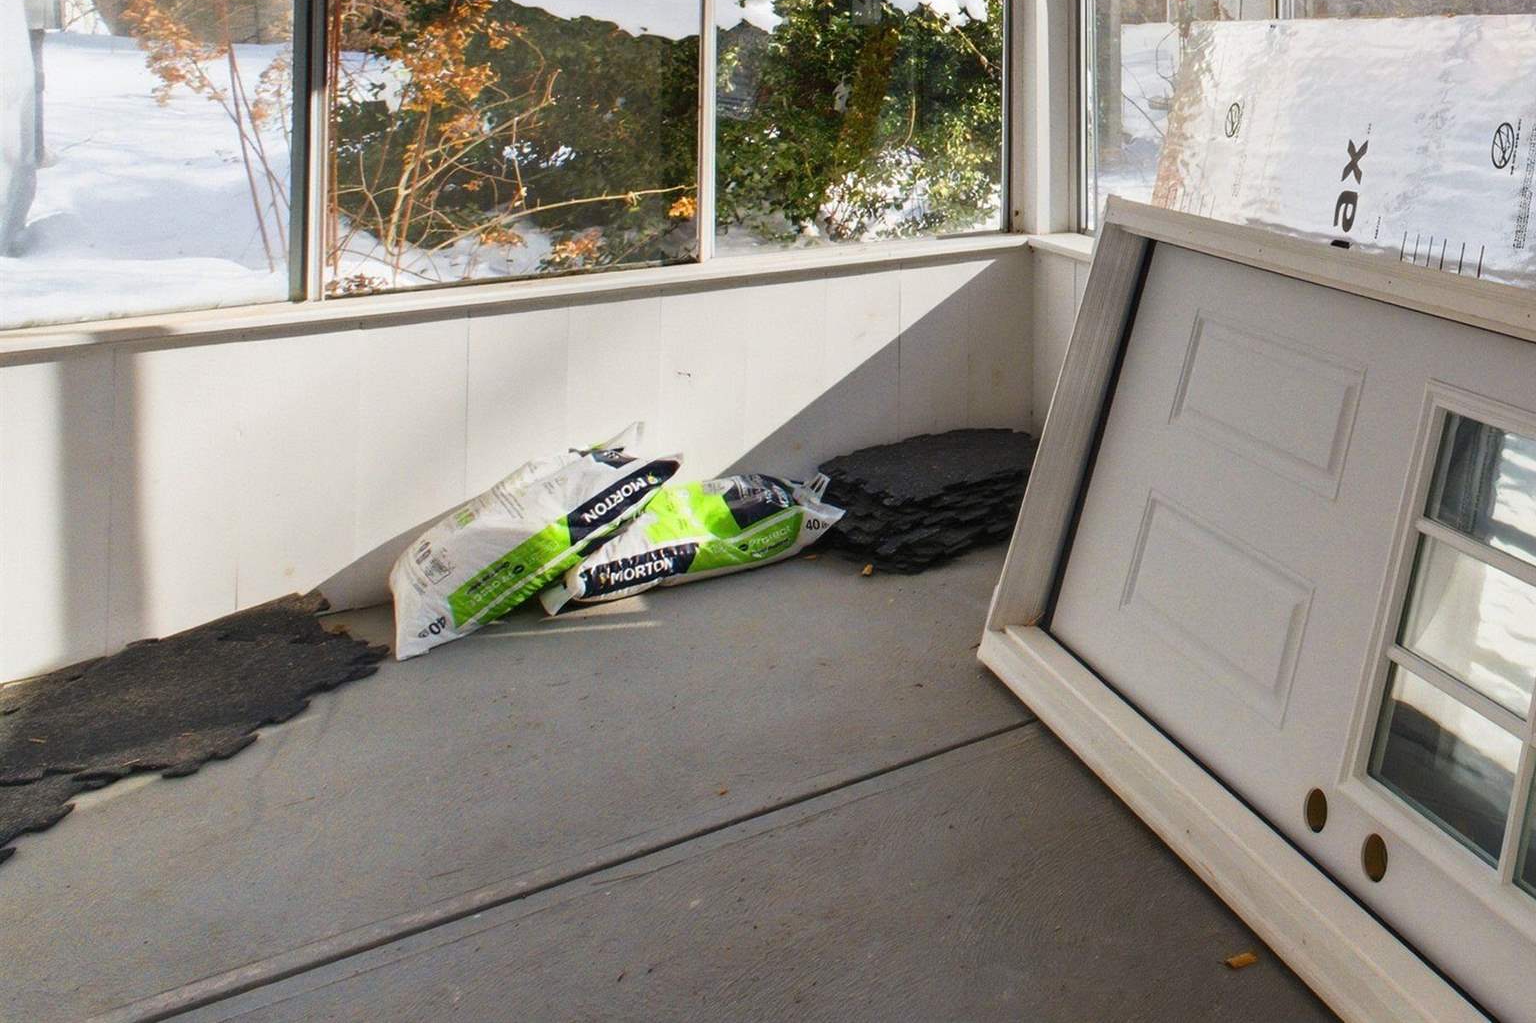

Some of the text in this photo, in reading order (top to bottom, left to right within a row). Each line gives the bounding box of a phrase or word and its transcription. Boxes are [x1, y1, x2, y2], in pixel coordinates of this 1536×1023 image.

[582, 474, 650, 524] MORTON
[805, 518, 821, 531] 40
[610, 557, 675, 586] MORTON
[428, 614, 448, 636] 40
